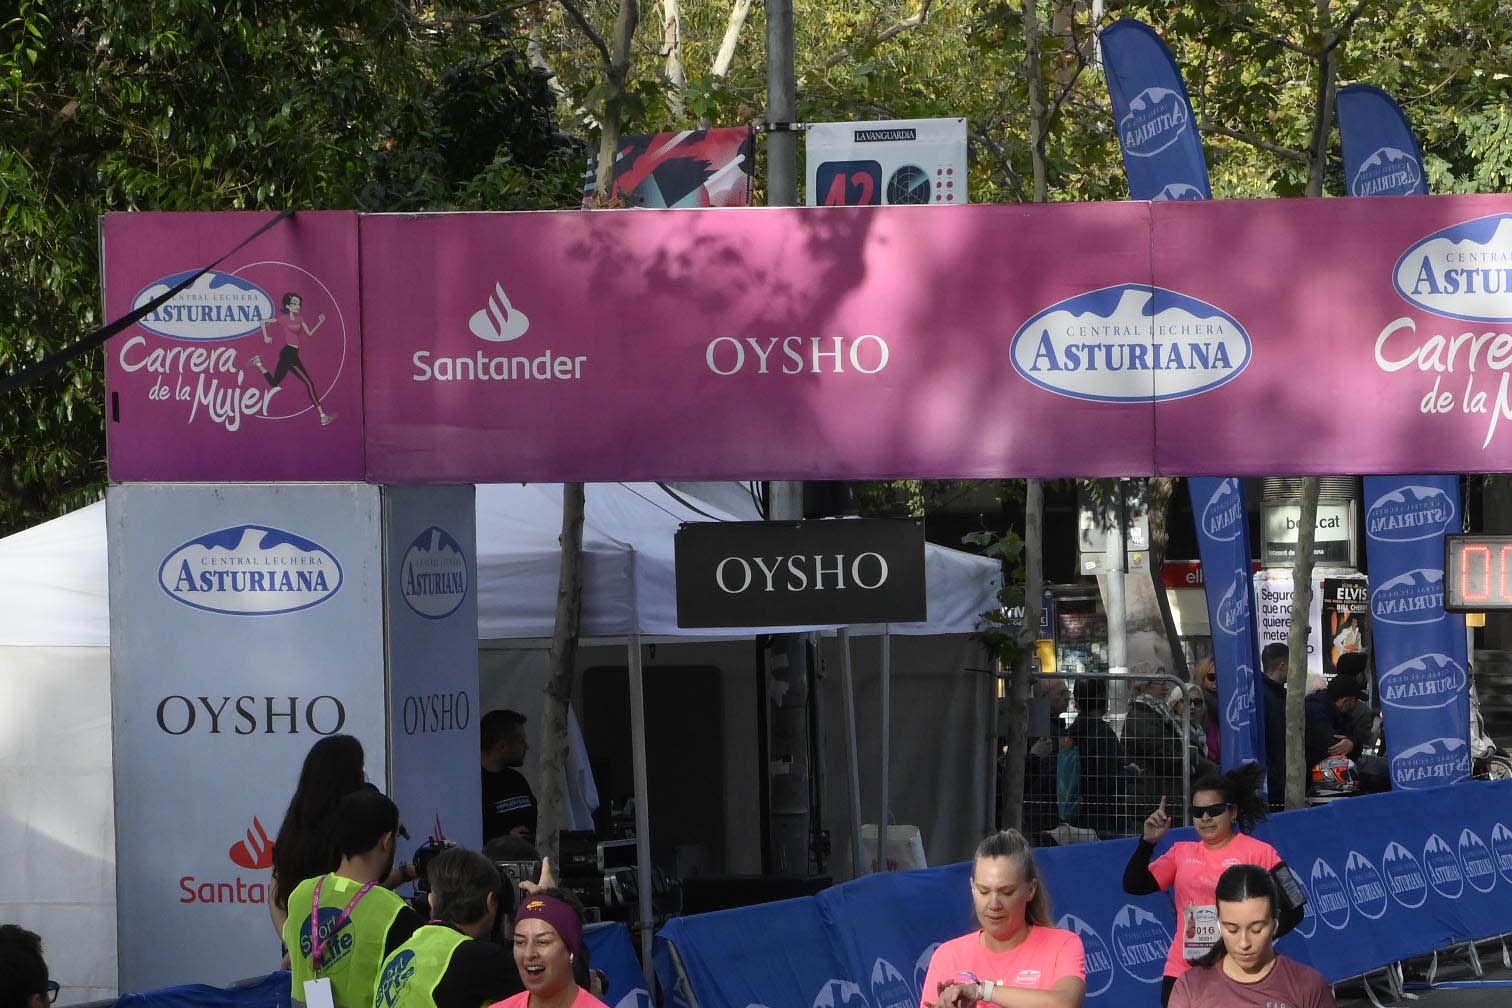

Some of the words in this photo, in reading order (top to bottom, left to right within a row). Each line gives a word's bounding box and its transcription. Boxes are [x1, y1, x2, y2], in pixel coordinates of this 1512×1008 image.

[170, 294, 207, 302] ENTRAL
[1066, 325, 1143, 337] CENTRAL
[119, 335, 238, 374] Carrera
[413, 349, 587, 383] Santander
[705, 334, 890, 376] OYSHO
[1029, 329, 1232, 373] ASTURIANA
[149, 375, 171, 400] de
[175, 374, 191, 400] la
[188, 370, 283, 432] Mujer
[1420, 376, 1455, 414] de
[1462, 375, 1487, 413] la
[173, 558, 330, 593] ASTURIANA
[201, 556, 261, 566] CENTRAL
[265, 556, 324, 566] LECHERA
[716, 552, 889, 594] OYSHO
[406, 562, 464, 596] ASTURIANA
[1336, 587, 1367, 600] ELVIS
[1262, 604, 1279, 616] que
[155, 695, 346, 736] OYSHO
[403, 691, 470, 736] OYSHO
[1196, 926, 1215, 935] 016
